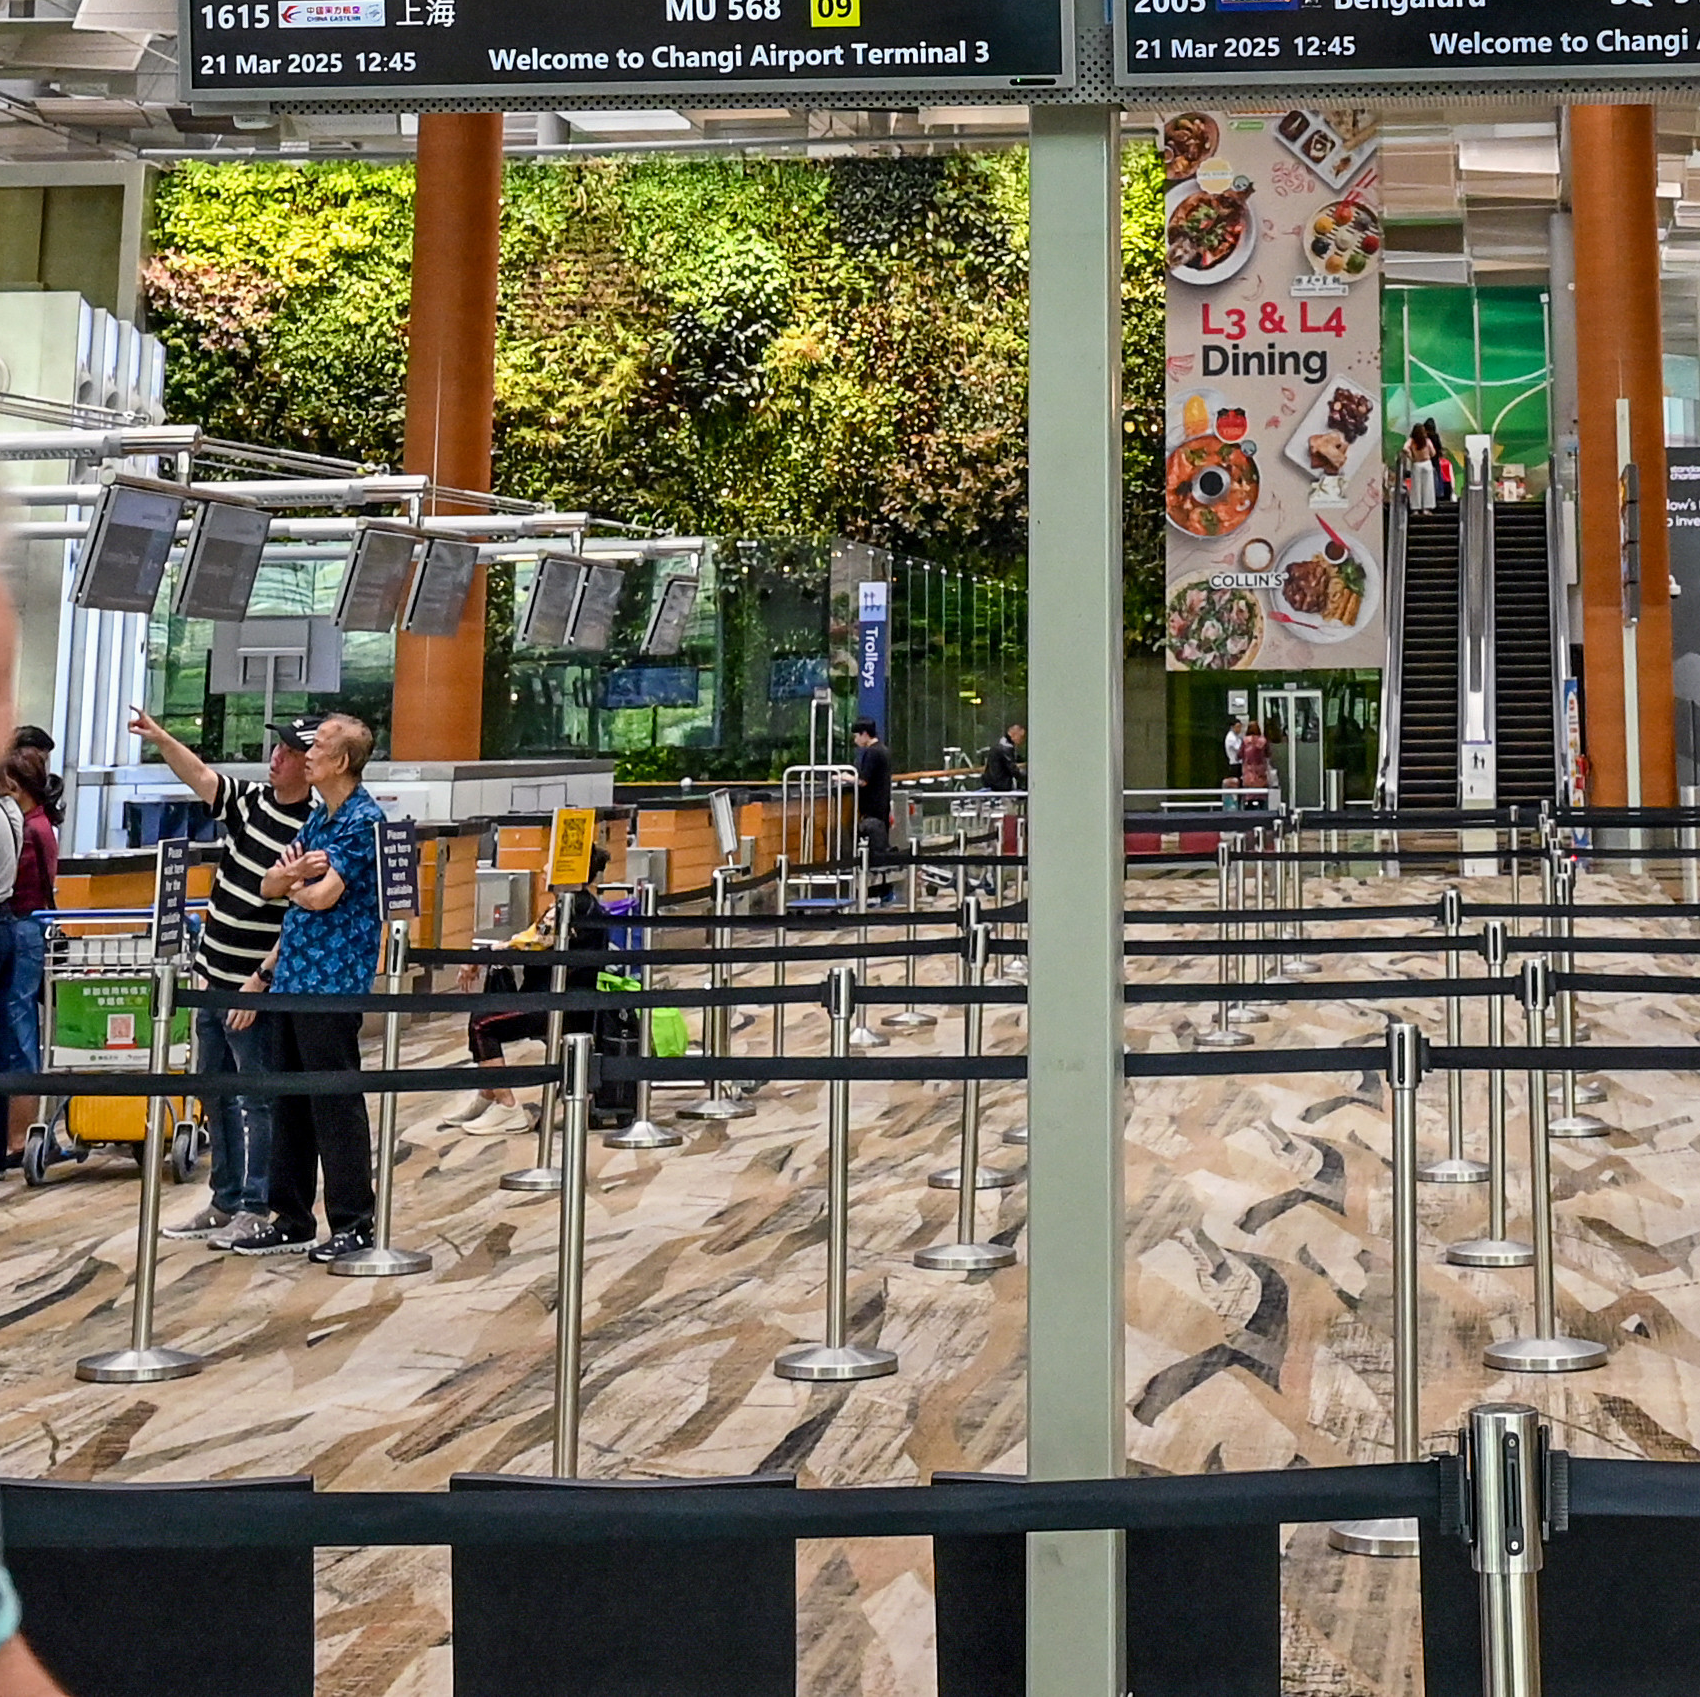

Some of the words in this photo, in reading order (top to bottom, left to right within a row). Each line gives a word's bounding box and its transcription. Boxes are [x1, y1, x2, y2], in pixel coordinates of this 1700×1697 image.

[200, 54, 226, 75] 21
[235, 54, 282, 75] Mar
[287, 52, 343, 74] 2025
[355, 51, 417, 73] 12:45
[487, 47, 609, 71] Welcome
[615, 48, 645, 69] to
[651, 43, 743, 74] Changi
[749, 43, 845, 73] Airport
[850, 39, 967, 65] Terminal
[974, 40, 990, 64] 3
[1201, 302, 1247, 341] L3
[1258, 301, 1288, 334] &
[1299, 301, 1347, 338] L4
[1202, 343, 1327, 384] Dining
[1211, 574, 1282, 587] COLLIN'S
[861, 626, 879, 688] Trolleys
[387, 830, 407, 839] Please
[384, 844, 396, 853] wait
[398, 844, 411, 853] here
[388, 858, 396, 867] for
[399, 857, 408, 867] the
